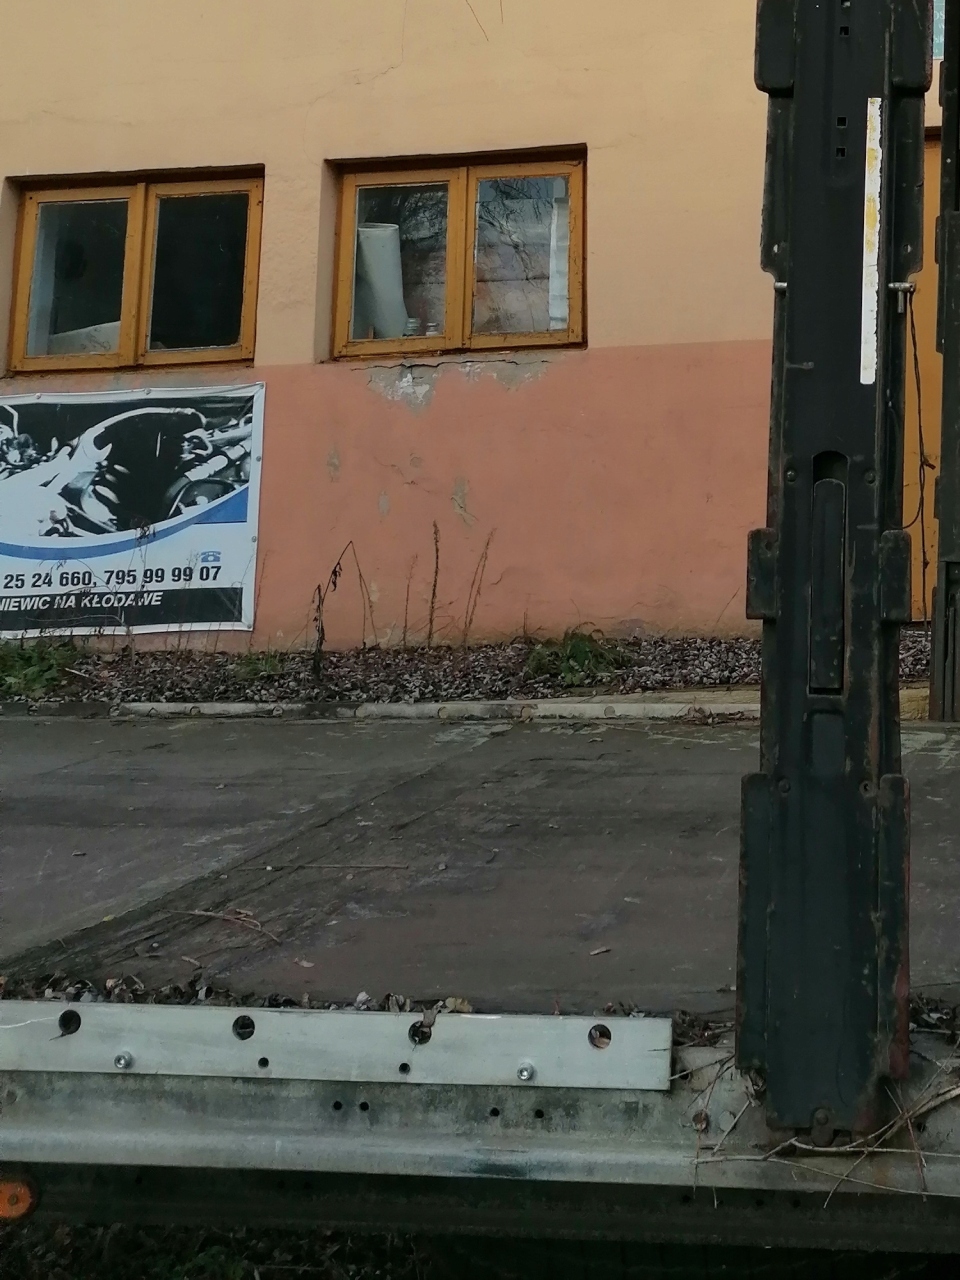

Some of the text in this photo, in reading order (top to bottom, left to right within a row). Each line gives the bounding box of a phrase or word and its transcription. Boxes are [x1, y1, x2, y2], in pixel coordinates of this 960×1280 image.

[2, 565, 222, 589] 25 24 660, 795 99 99 07
[54, 594, 76, 609] NA
[81, 590, 164, 607] KŁODAWE
